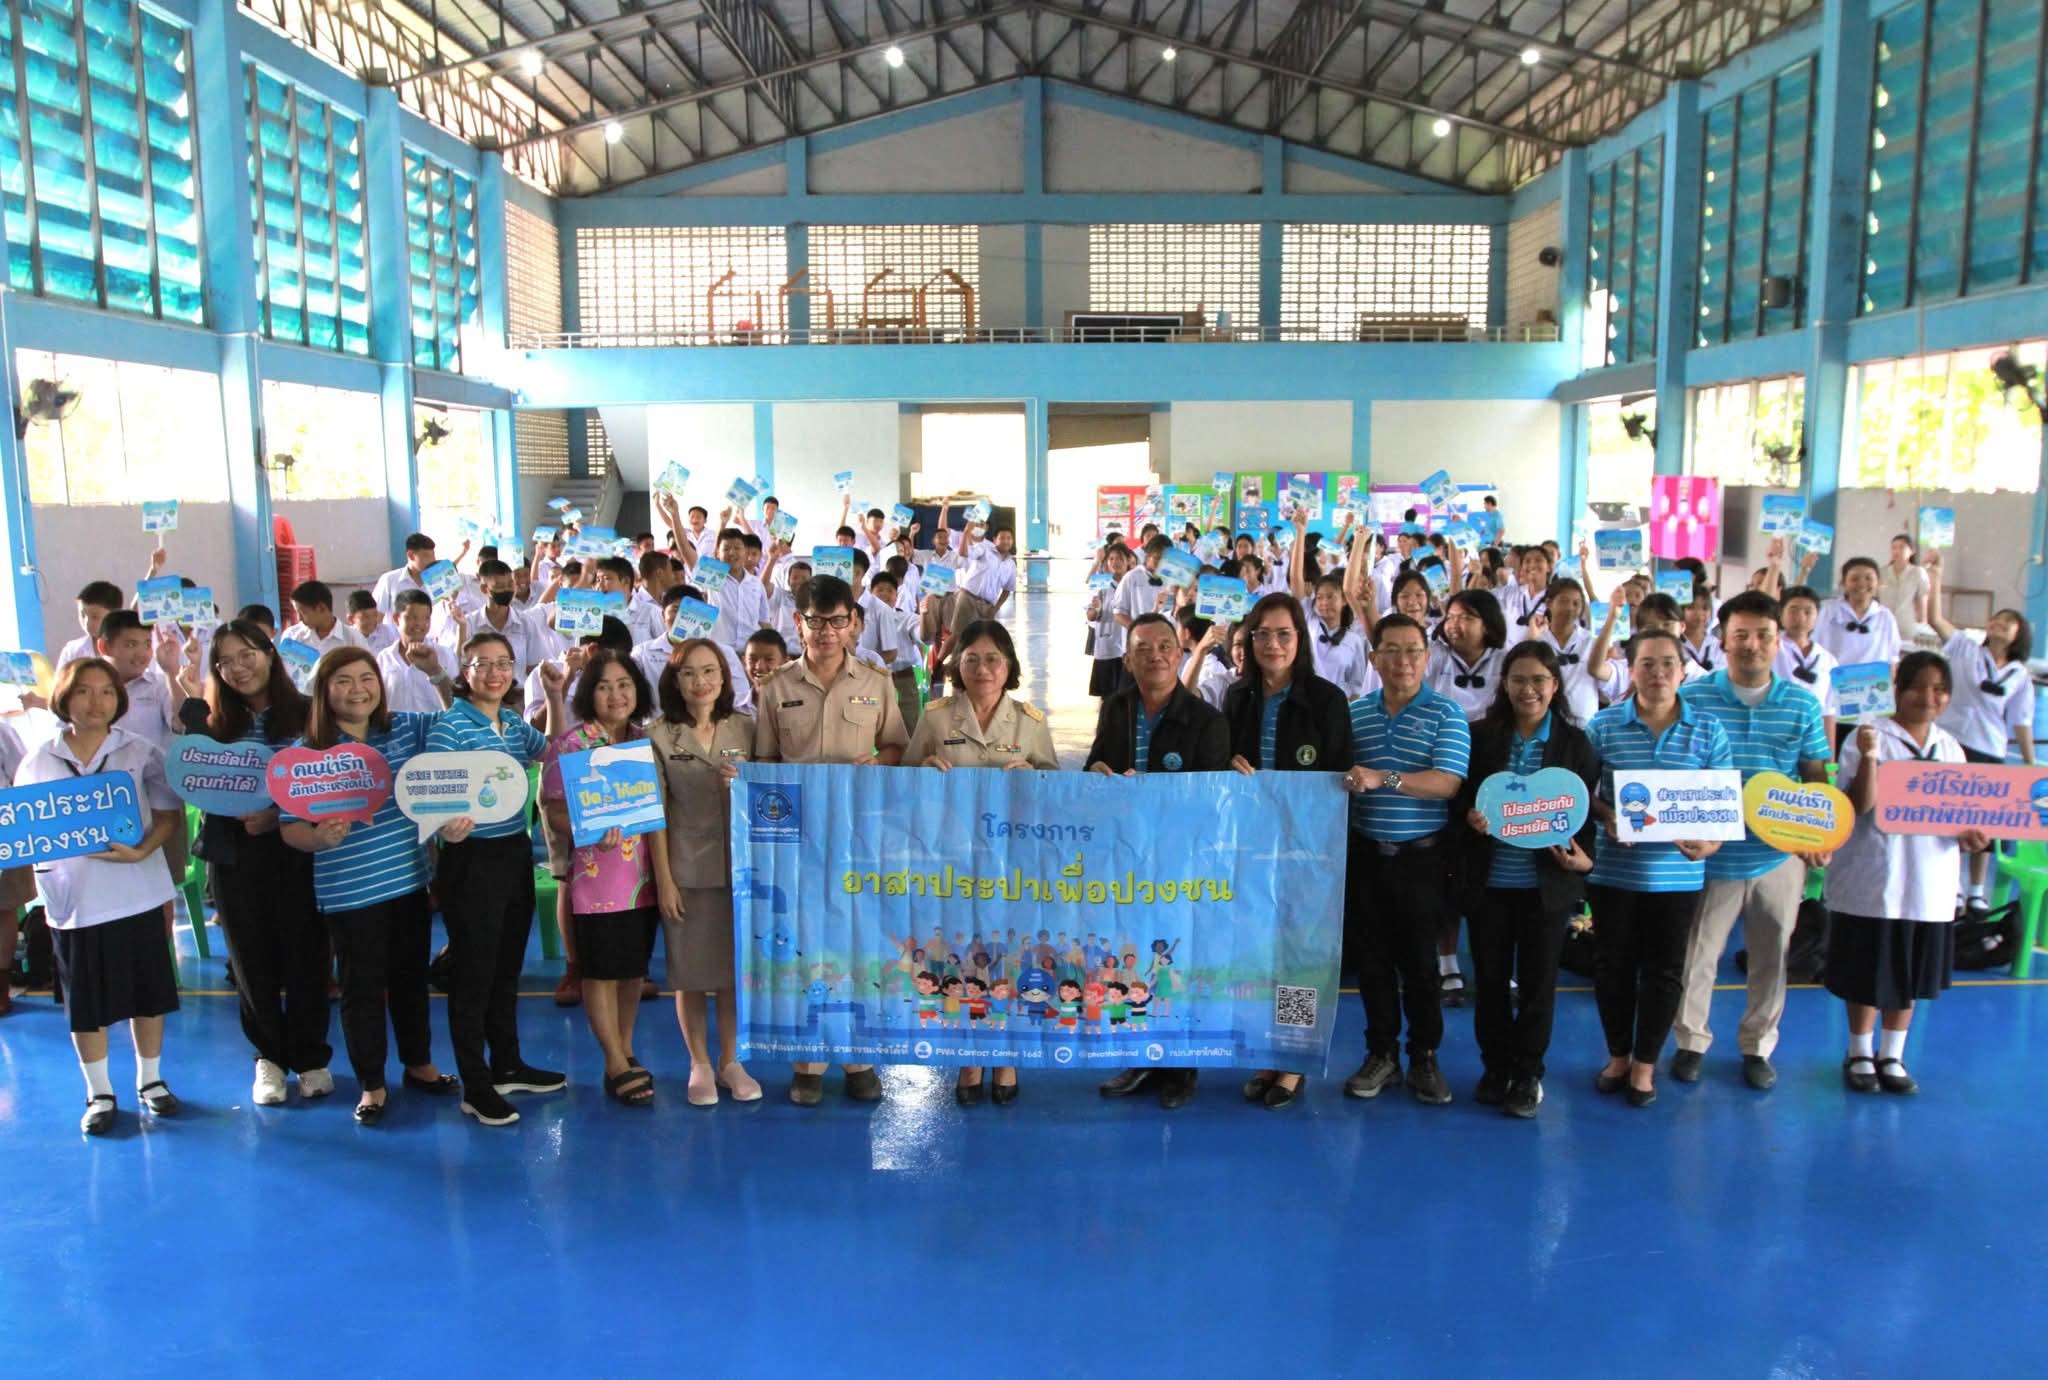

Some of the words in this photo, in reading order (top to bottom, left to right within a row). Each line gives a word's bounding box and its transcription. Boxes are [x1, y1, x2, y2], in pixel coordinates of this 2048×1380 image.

[291, 752, 366, 778] คนน่ารัก
[406, 770, 431, 781] SAVE
[433, 769, 469, 779] WATER
[183, 773, 258, 793] คุณทำได้!
[406, 785, 428, 796] YOU
[0, 782, 131, 827] สาประปา
[1501, 794, 1575, 818] โปรดช่วยกัน
[1767, 787, 1832, 811] คนน่ารัก
[1658, 802, 1738, 824] เพื่อปวงชน
[981, 813, 1095, 842] โครงการ
[1501, 816, 1550, 838] ประหยัด
[0, 825, 110, 860] อปวงชน
[842, 852, 1234, 905] อาสาประปาเพื่อปวงชน
[935, 1049, 956, 1057] PWA
[958, 1049, 989, 1057] Contact
[992, 1049, 1019, 1058] Center
[1022, 1049, 1044, 1058] 1662
